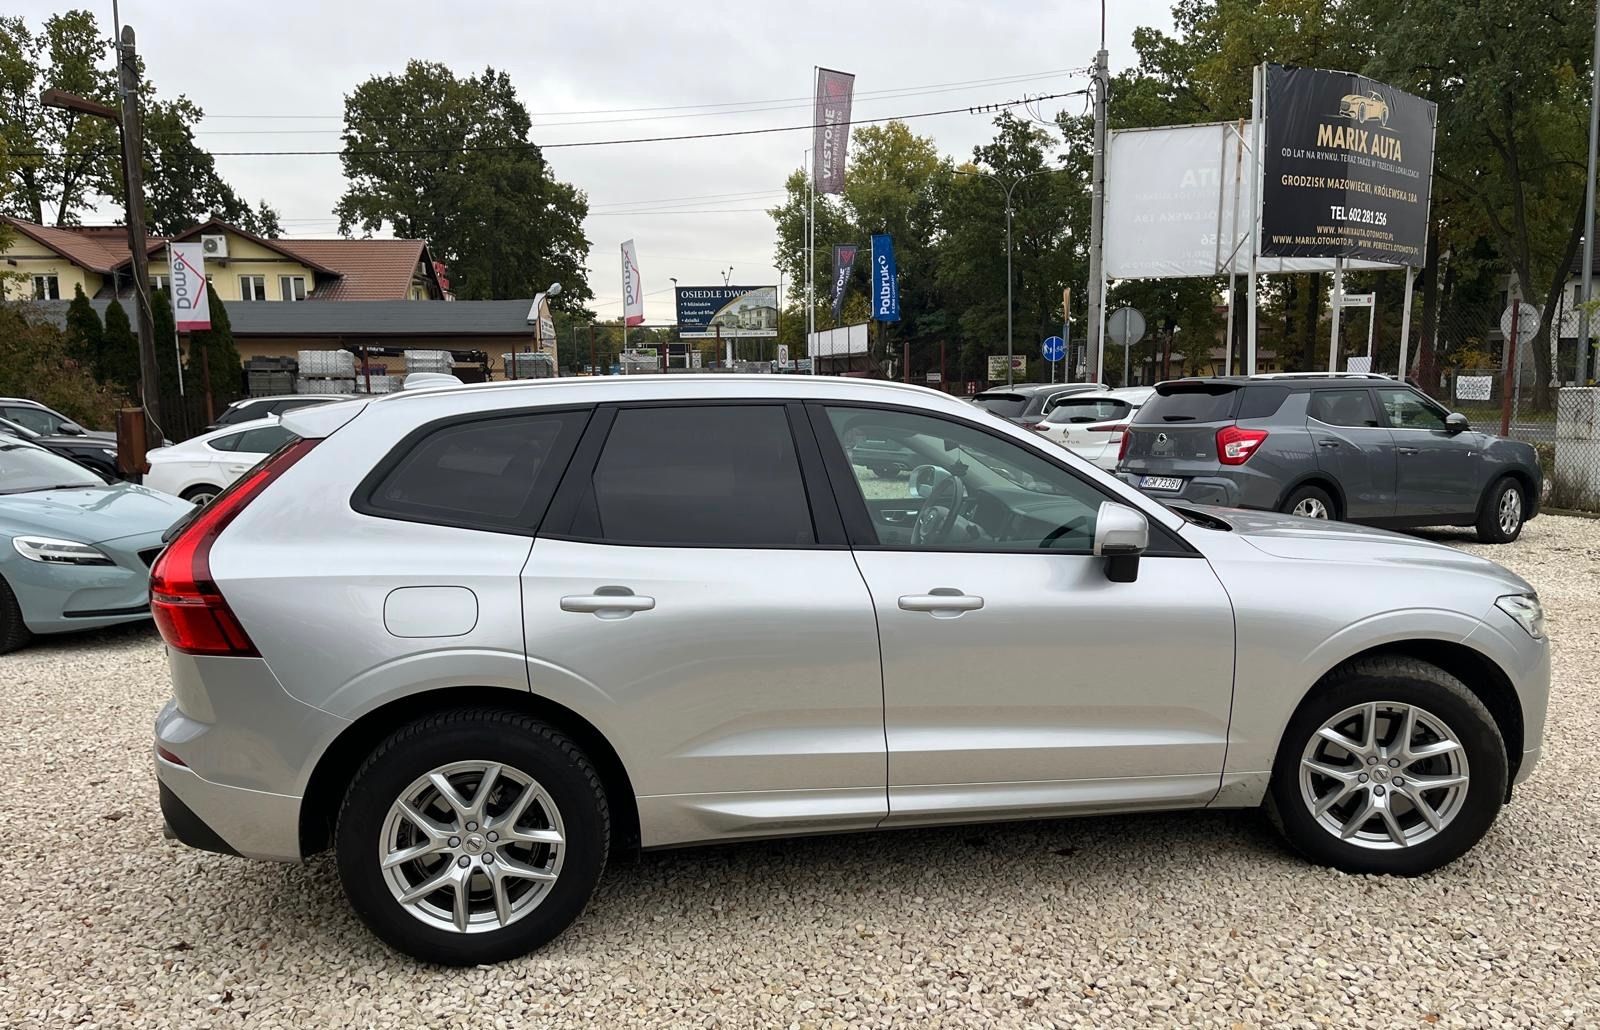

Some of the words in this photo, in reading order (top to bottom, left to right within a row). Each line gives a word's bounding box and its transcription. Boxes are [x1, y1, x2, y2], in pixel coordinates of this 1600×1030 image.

[823, 108, 835, 179] VESTONE
[1317, 123, 1369, 153] MARIX
[1371, 134, 1402, 162] AUTA
[1281, 147, 1291, 157] OD
[1293, 149, 1305, 159] LAT
[1306, 150, 1315, 159] NA
[1316, 151, 1339, 162] RYNKU.
[1340, 153, 1356, 164] TERAZ
[1281, 174, 1325, 188] GRODZISK
[1327, 177, 1373, 195] MAZOWIECKI,
[1373, 184, 1407, 201] KRÓLEWSKA
[1407, 192, 1418, 203] 18A
[1330, 205, 1347, 220] TEL.
[1348, 207, 1361, 222] 602
[1362, 209, 1374, 224] 281
[1375, 212, 1387, 226] 256
[1295, 236, 1353, 246] MARIX.OTOMOTO.PL
[681, 290, 721, 298] OSIEDLE
[880, 264, 890, 315] Polbruk
[1158, 478, 1182, 489] 7338V
